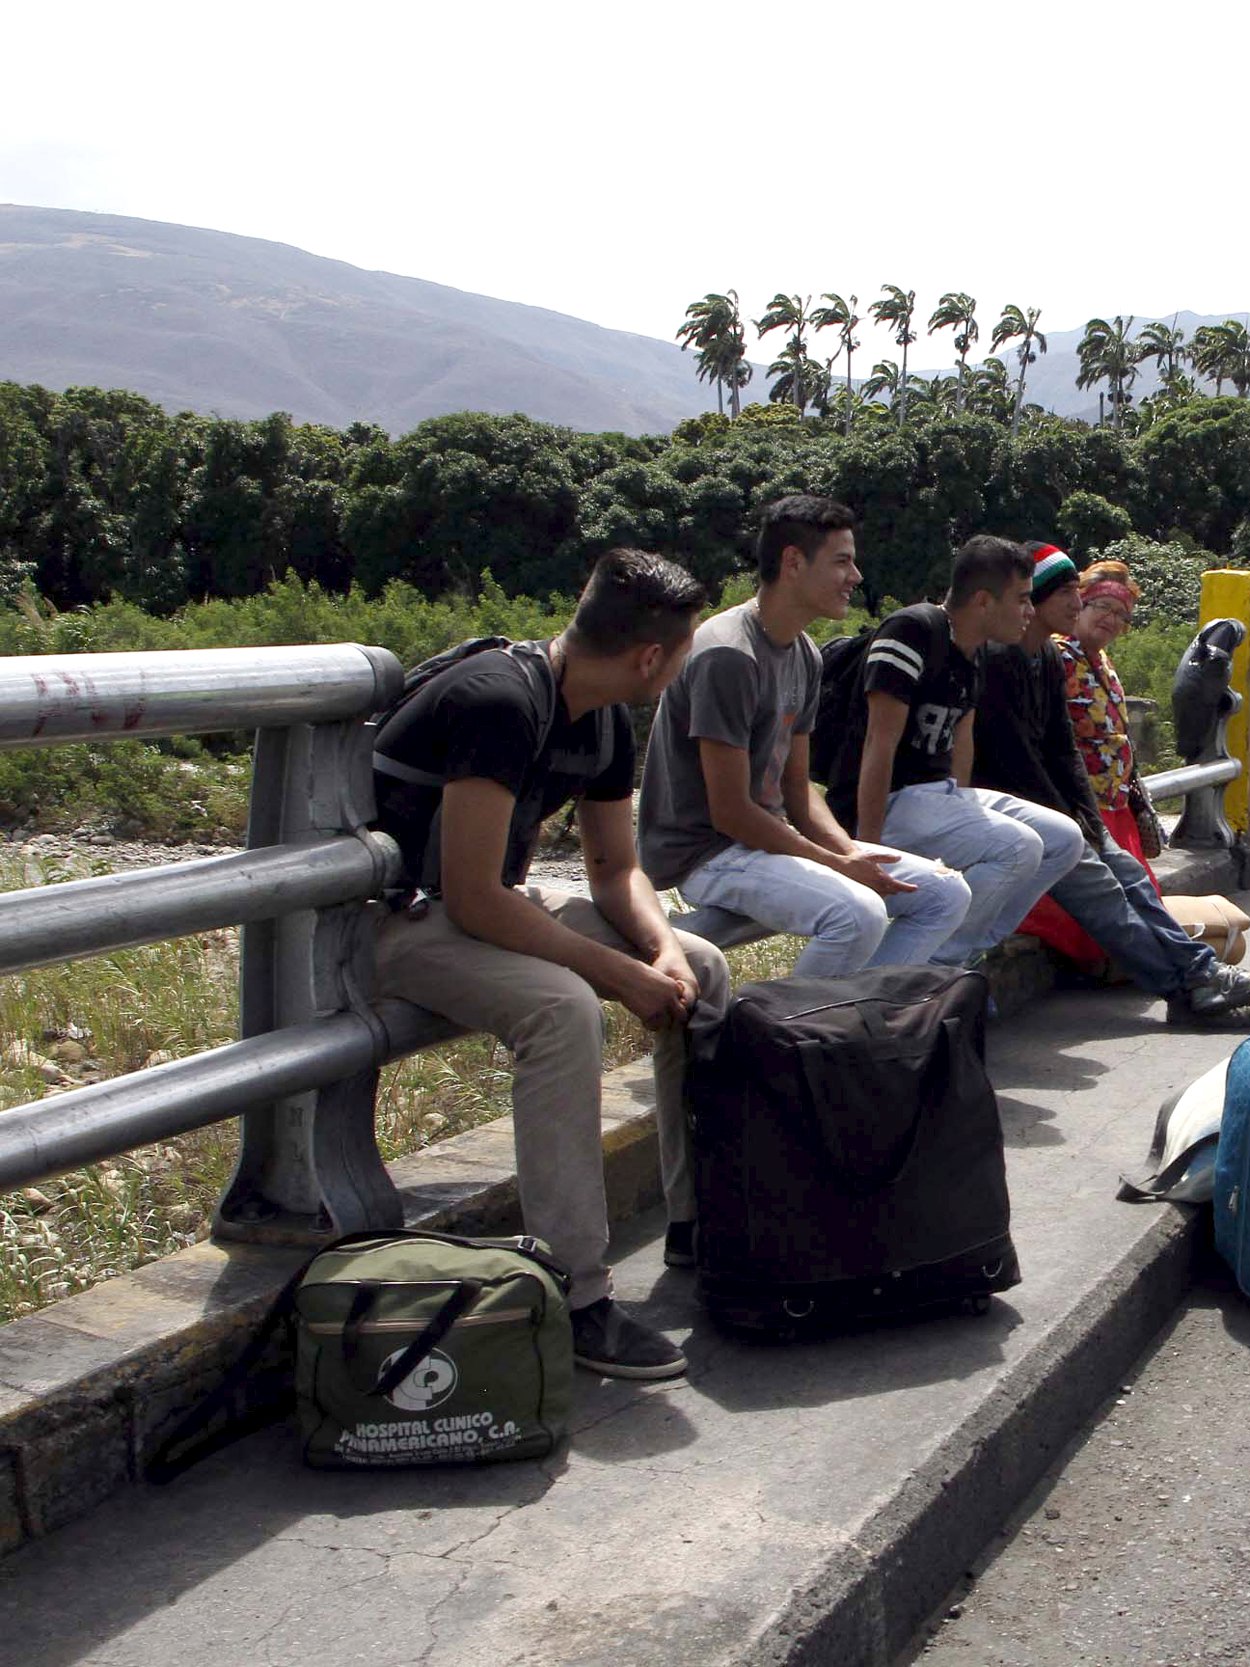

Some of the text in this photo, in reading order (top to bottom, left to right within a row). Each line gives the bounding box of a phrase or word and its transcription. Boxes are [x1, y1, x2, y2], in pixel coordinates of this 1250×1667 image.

[356, 1411, 493, 1438] HOSPITAL CLINICO
[488, 1420, 521, 1440] C.A.
